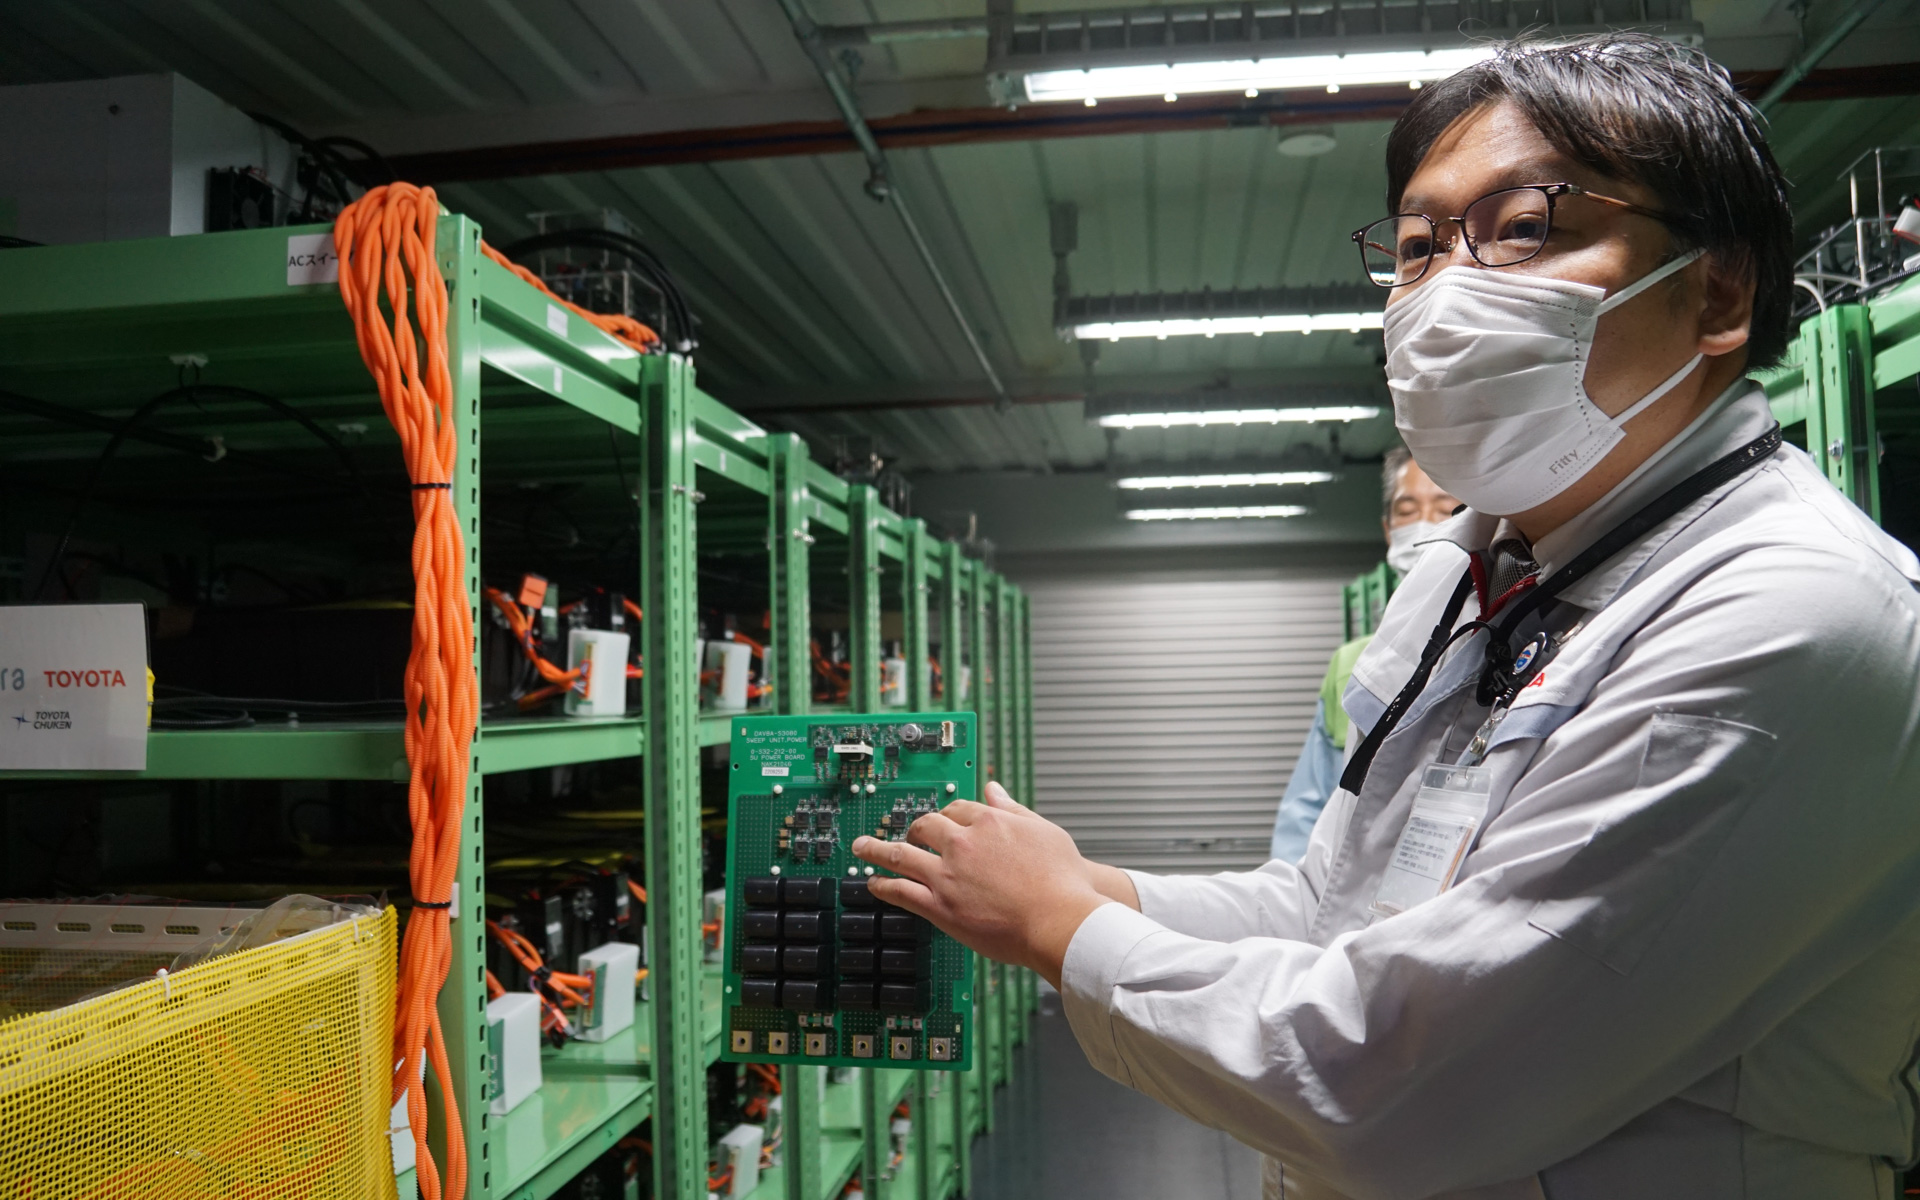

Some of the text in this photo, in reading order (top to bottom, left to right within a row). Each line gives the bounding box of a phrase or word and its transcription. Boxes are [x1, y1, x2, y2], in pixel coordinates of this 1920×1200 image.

[1549, 449, 1579, 475] Fitty
[44, 670, 126, 688] TOYOTA
[35, 711, 70, 720] TOYOTA
[33, 720, 72, 730] CHUKEN
